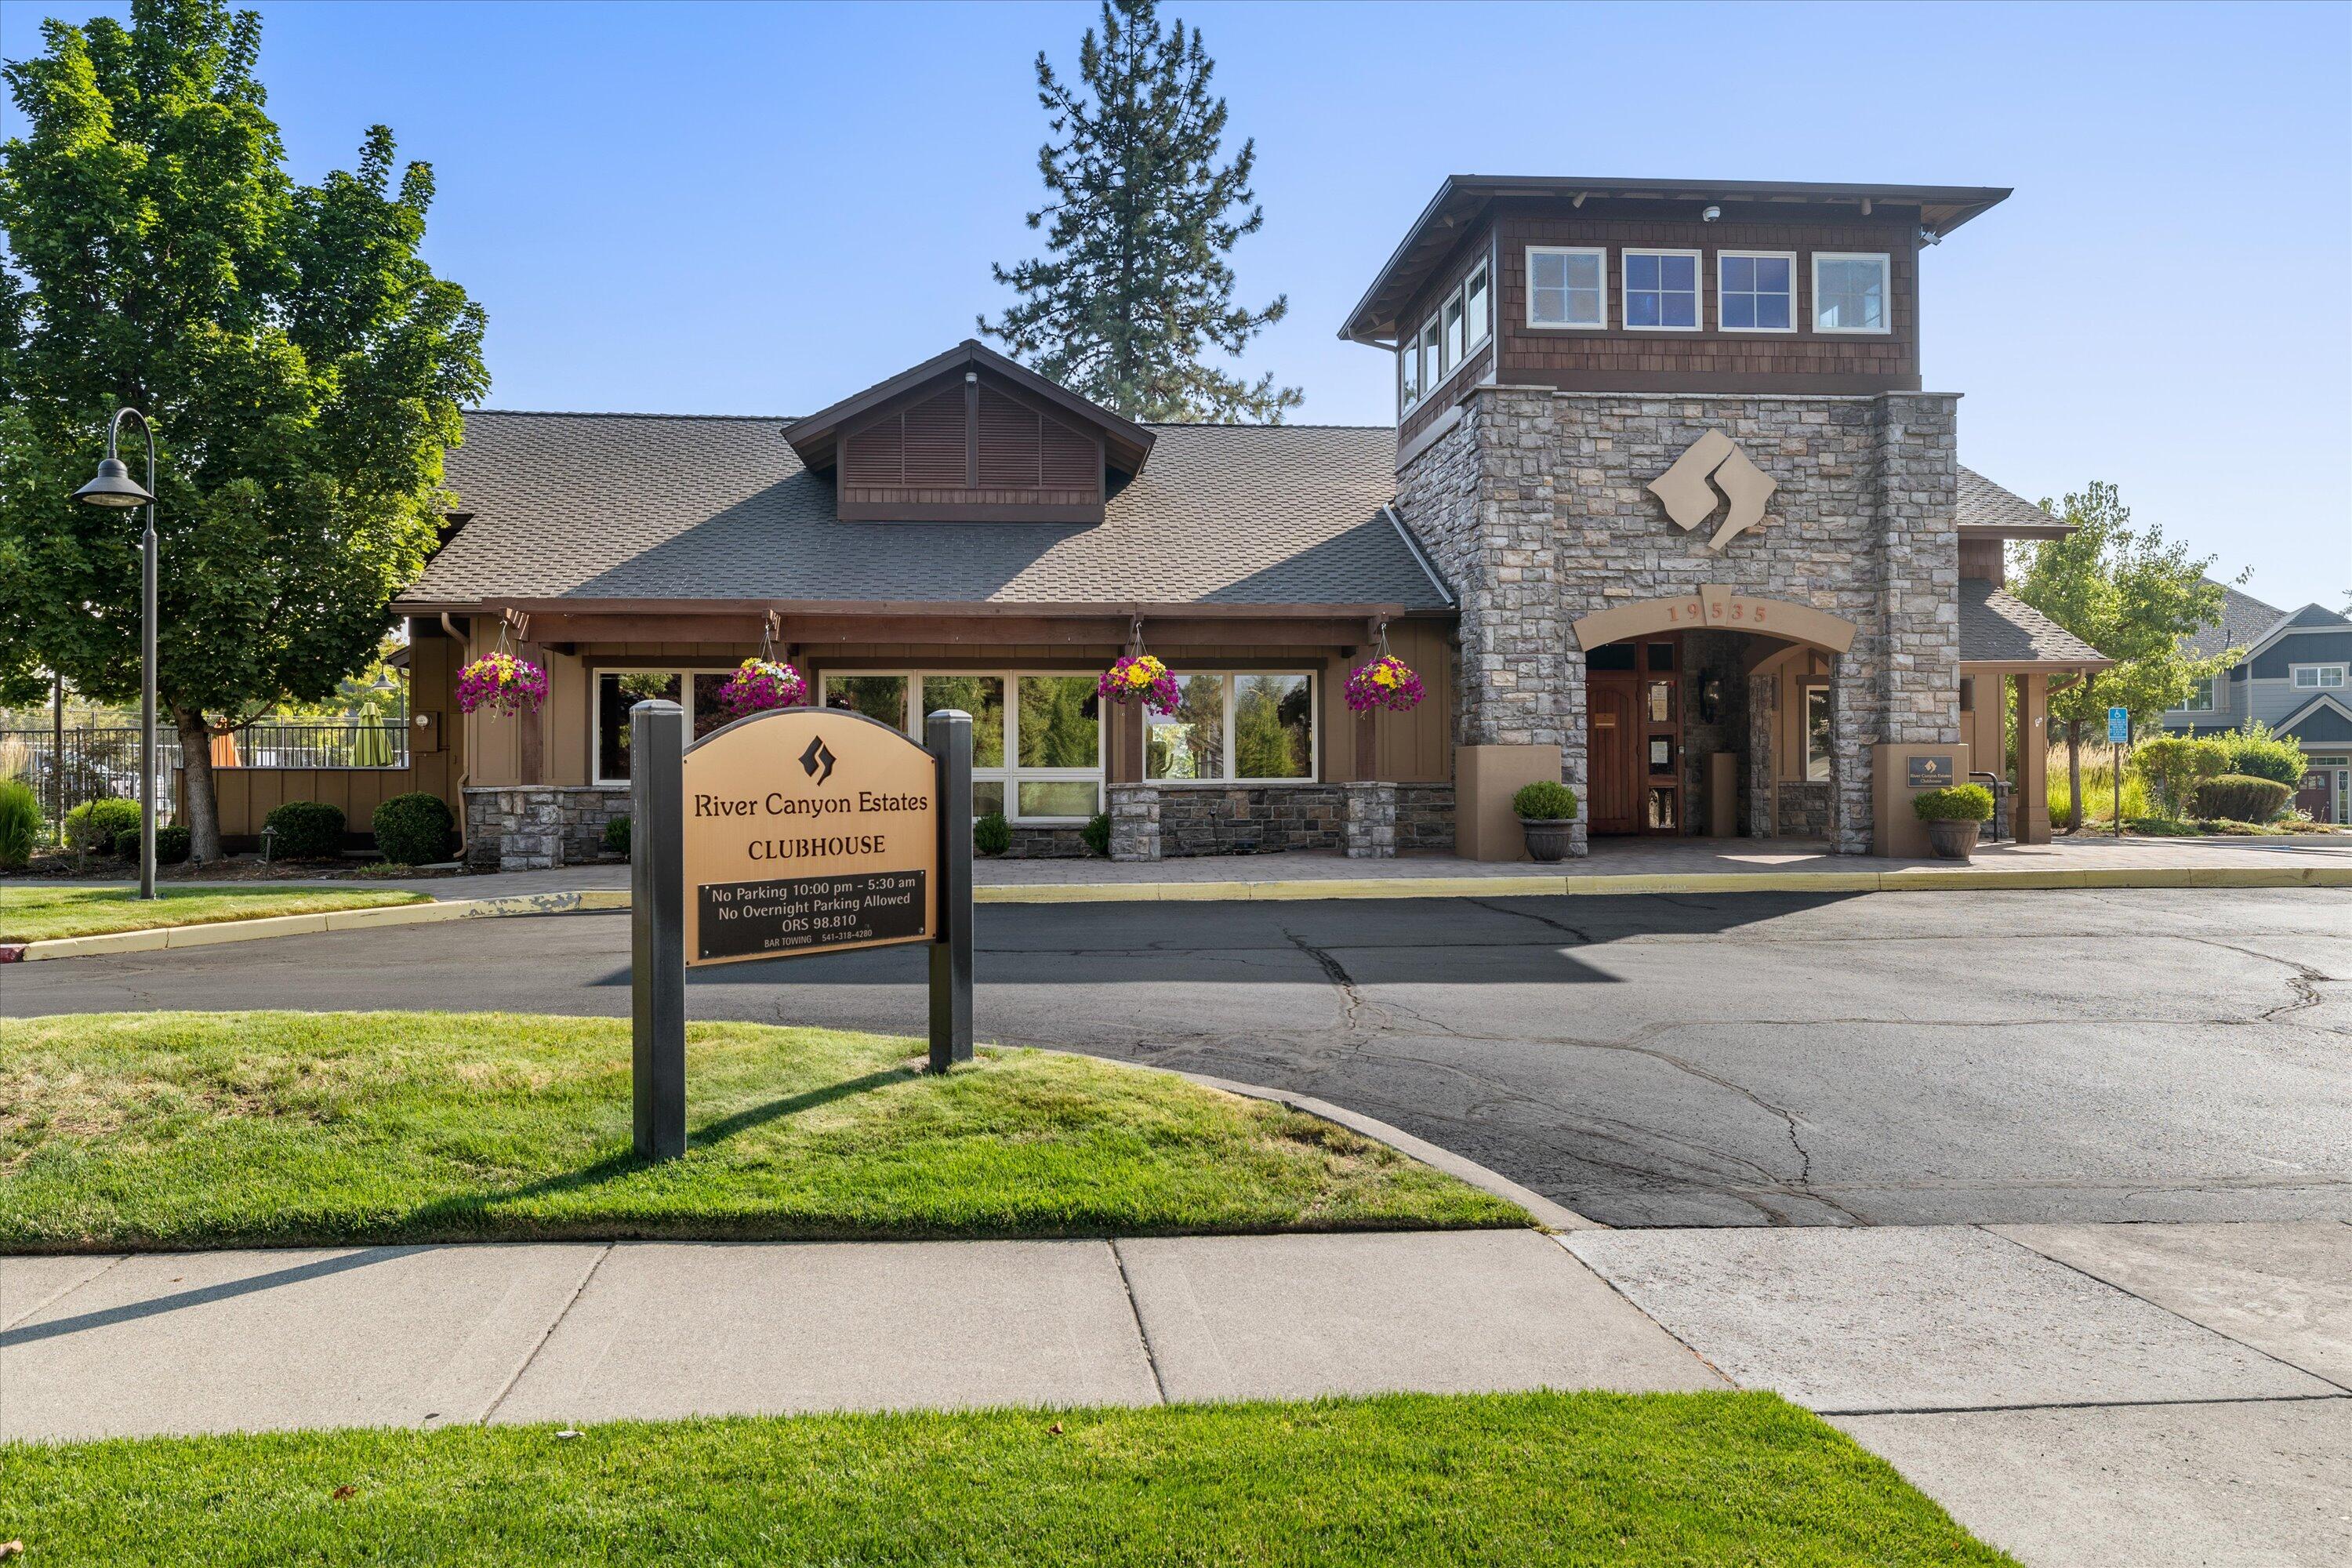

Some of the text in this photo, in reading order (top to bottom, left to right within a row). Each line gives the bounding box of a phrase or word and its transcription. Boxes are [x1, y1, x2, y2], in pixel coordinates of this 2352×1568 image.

[1666, 601, 1767, 623] 19535
[695, 791, 927, 818] River Canyon Estates
[748, 835, 886, 860] CLUBHOUSE
[712, 889, 731, 902] No
[737, 886, 787, 901] Parking
[793, 883, 829, 896] 10:00
[833, 883, 853, 895] pm
[868, 877, 895, 891] 5:30
[898, 878, 916, 888] am
[719, 892, 910, 920] No Overnight Parking Allowed
[782, 914, 856, 932] ORS 98.810
[764, 929, 873, 948] BAR TOWING 541-318-4280
